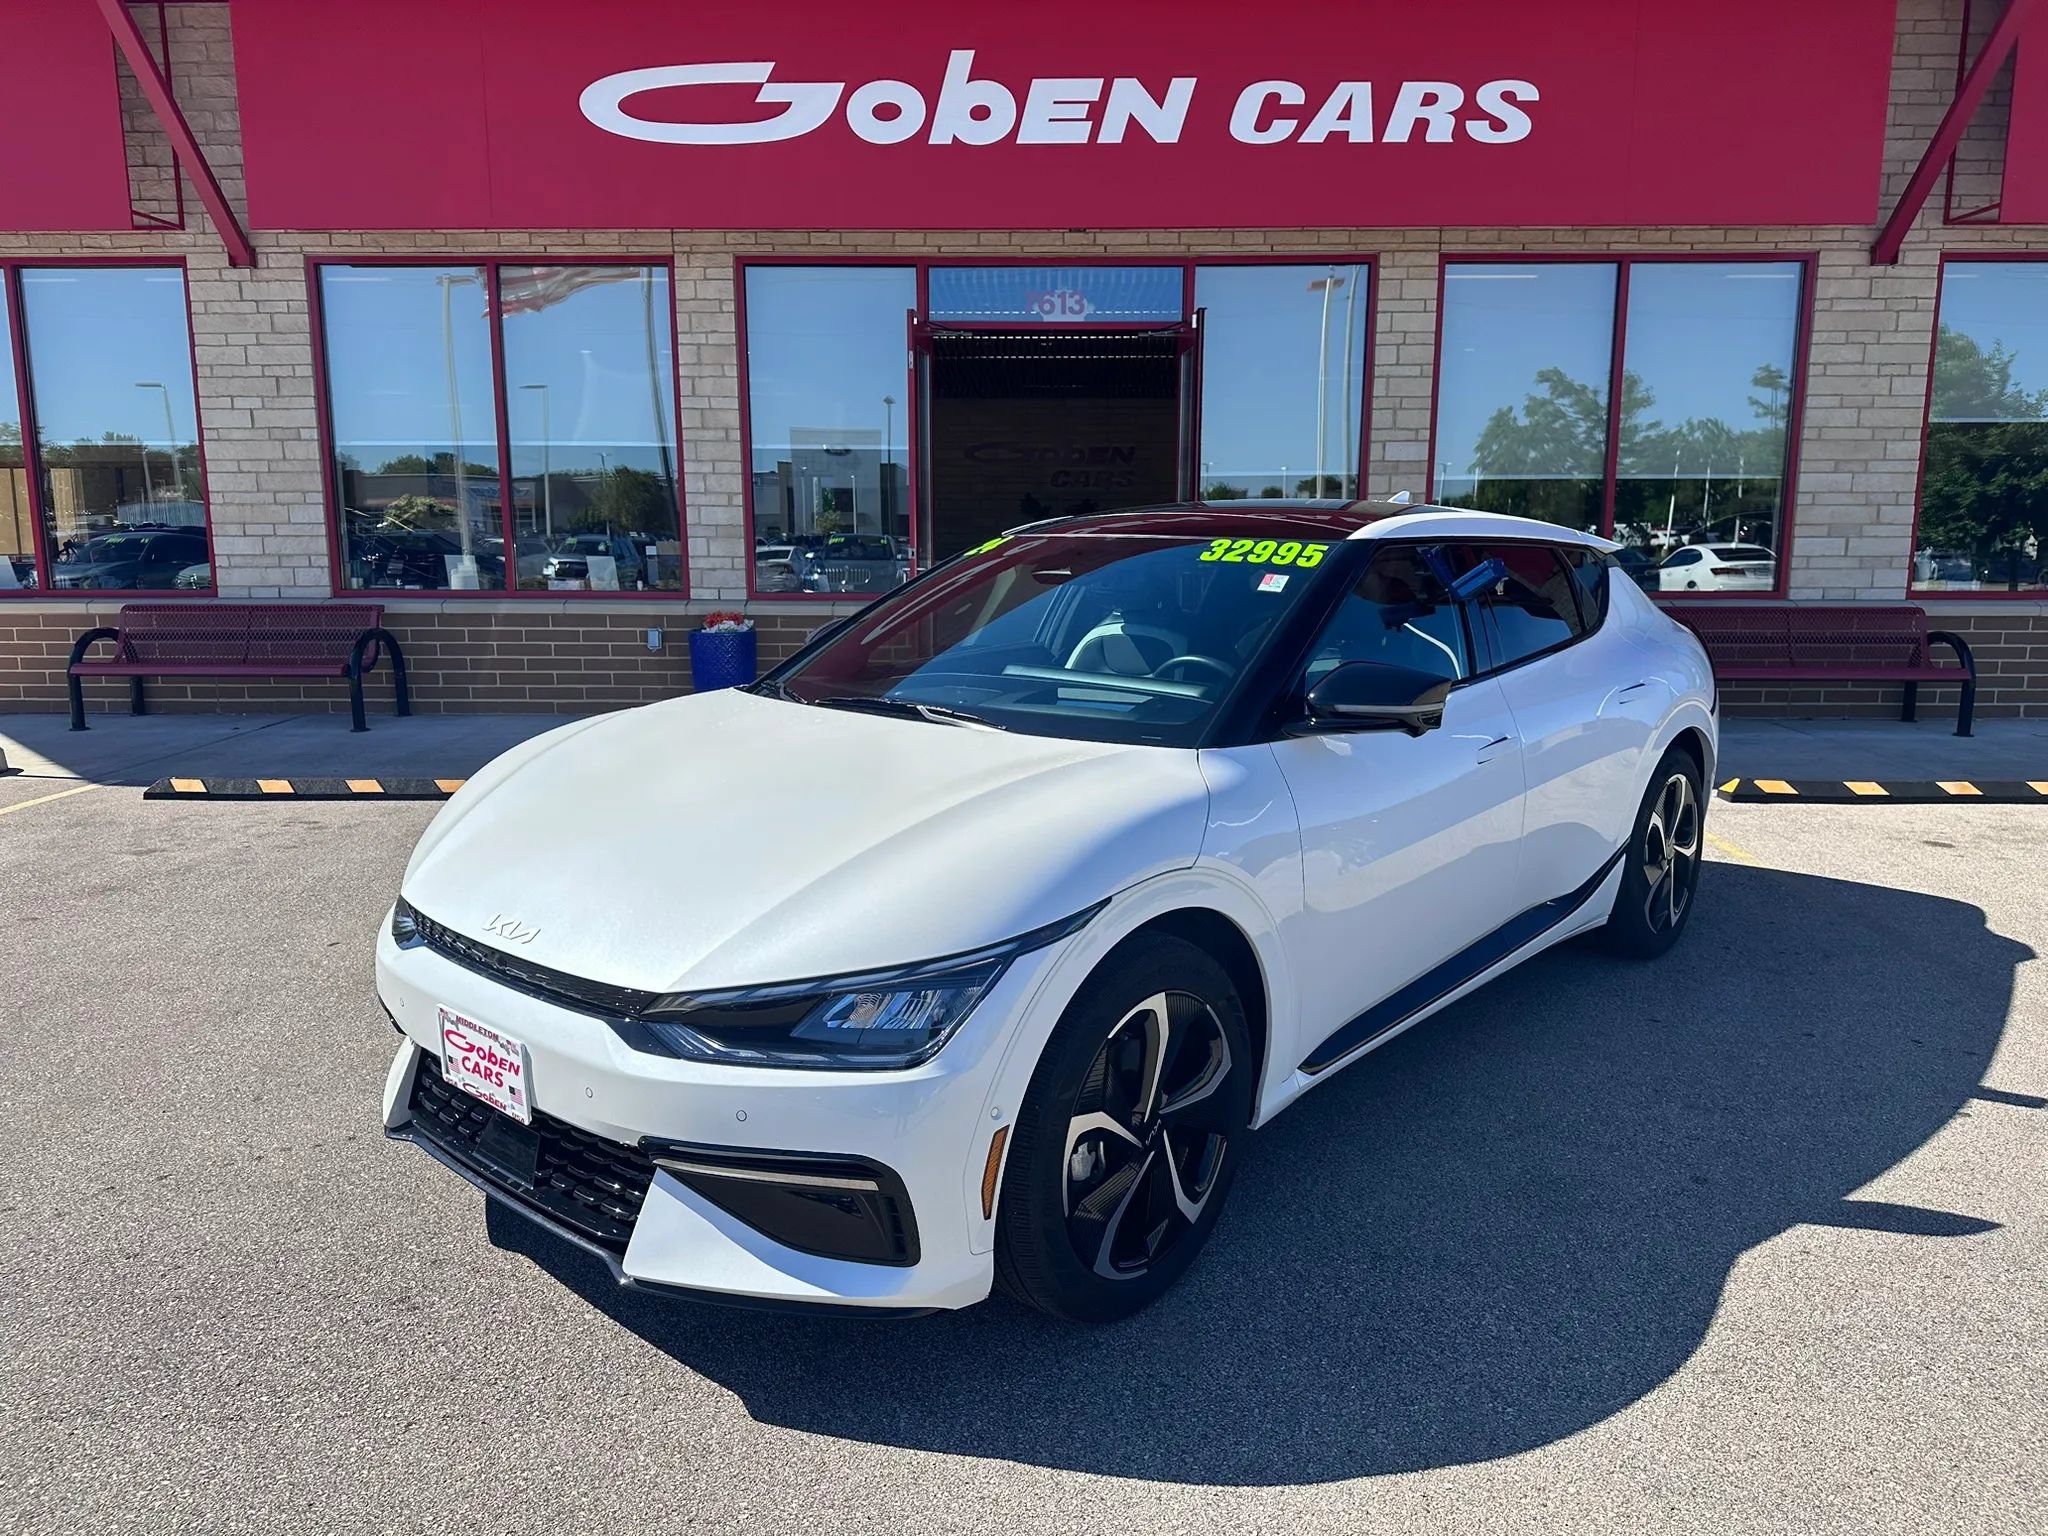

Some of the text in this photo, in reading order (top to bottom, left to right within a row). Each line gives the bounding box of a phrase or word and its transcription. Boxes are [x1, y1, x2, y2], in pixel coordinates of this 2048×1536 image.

[1230, 79, 1541, 145] CARS
[1200, 539, 1329, 568] 32995
[481, 913, 542, 944] KIA
[455, 1015, 500, 1042] MIDDLETON
[461, 1056, 504, 1088] CARS
